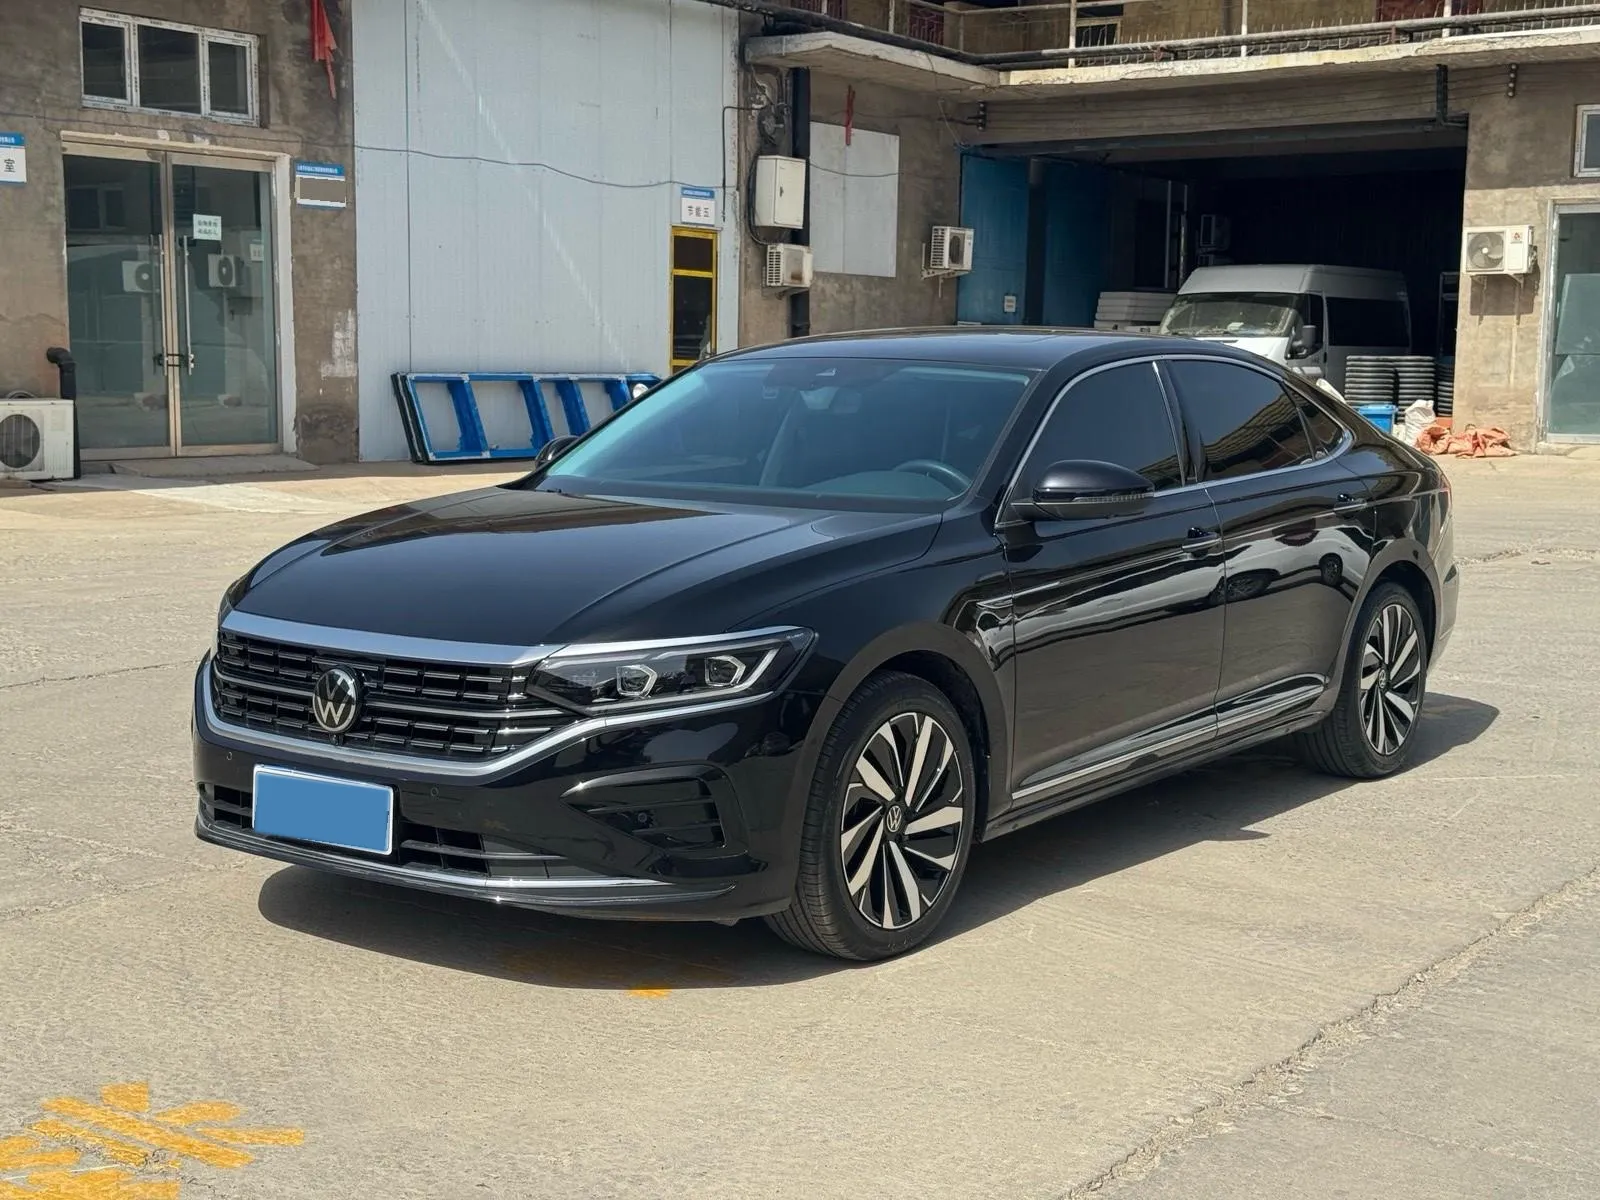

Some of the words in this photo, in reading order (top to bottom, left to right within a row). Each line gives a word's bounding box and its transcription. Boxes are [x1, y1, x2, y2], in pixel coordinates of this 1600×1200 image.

[4, 158, 16, 173] 室
[315, 670, 355, 728] VW
[887, 806, 901, 832] VW
